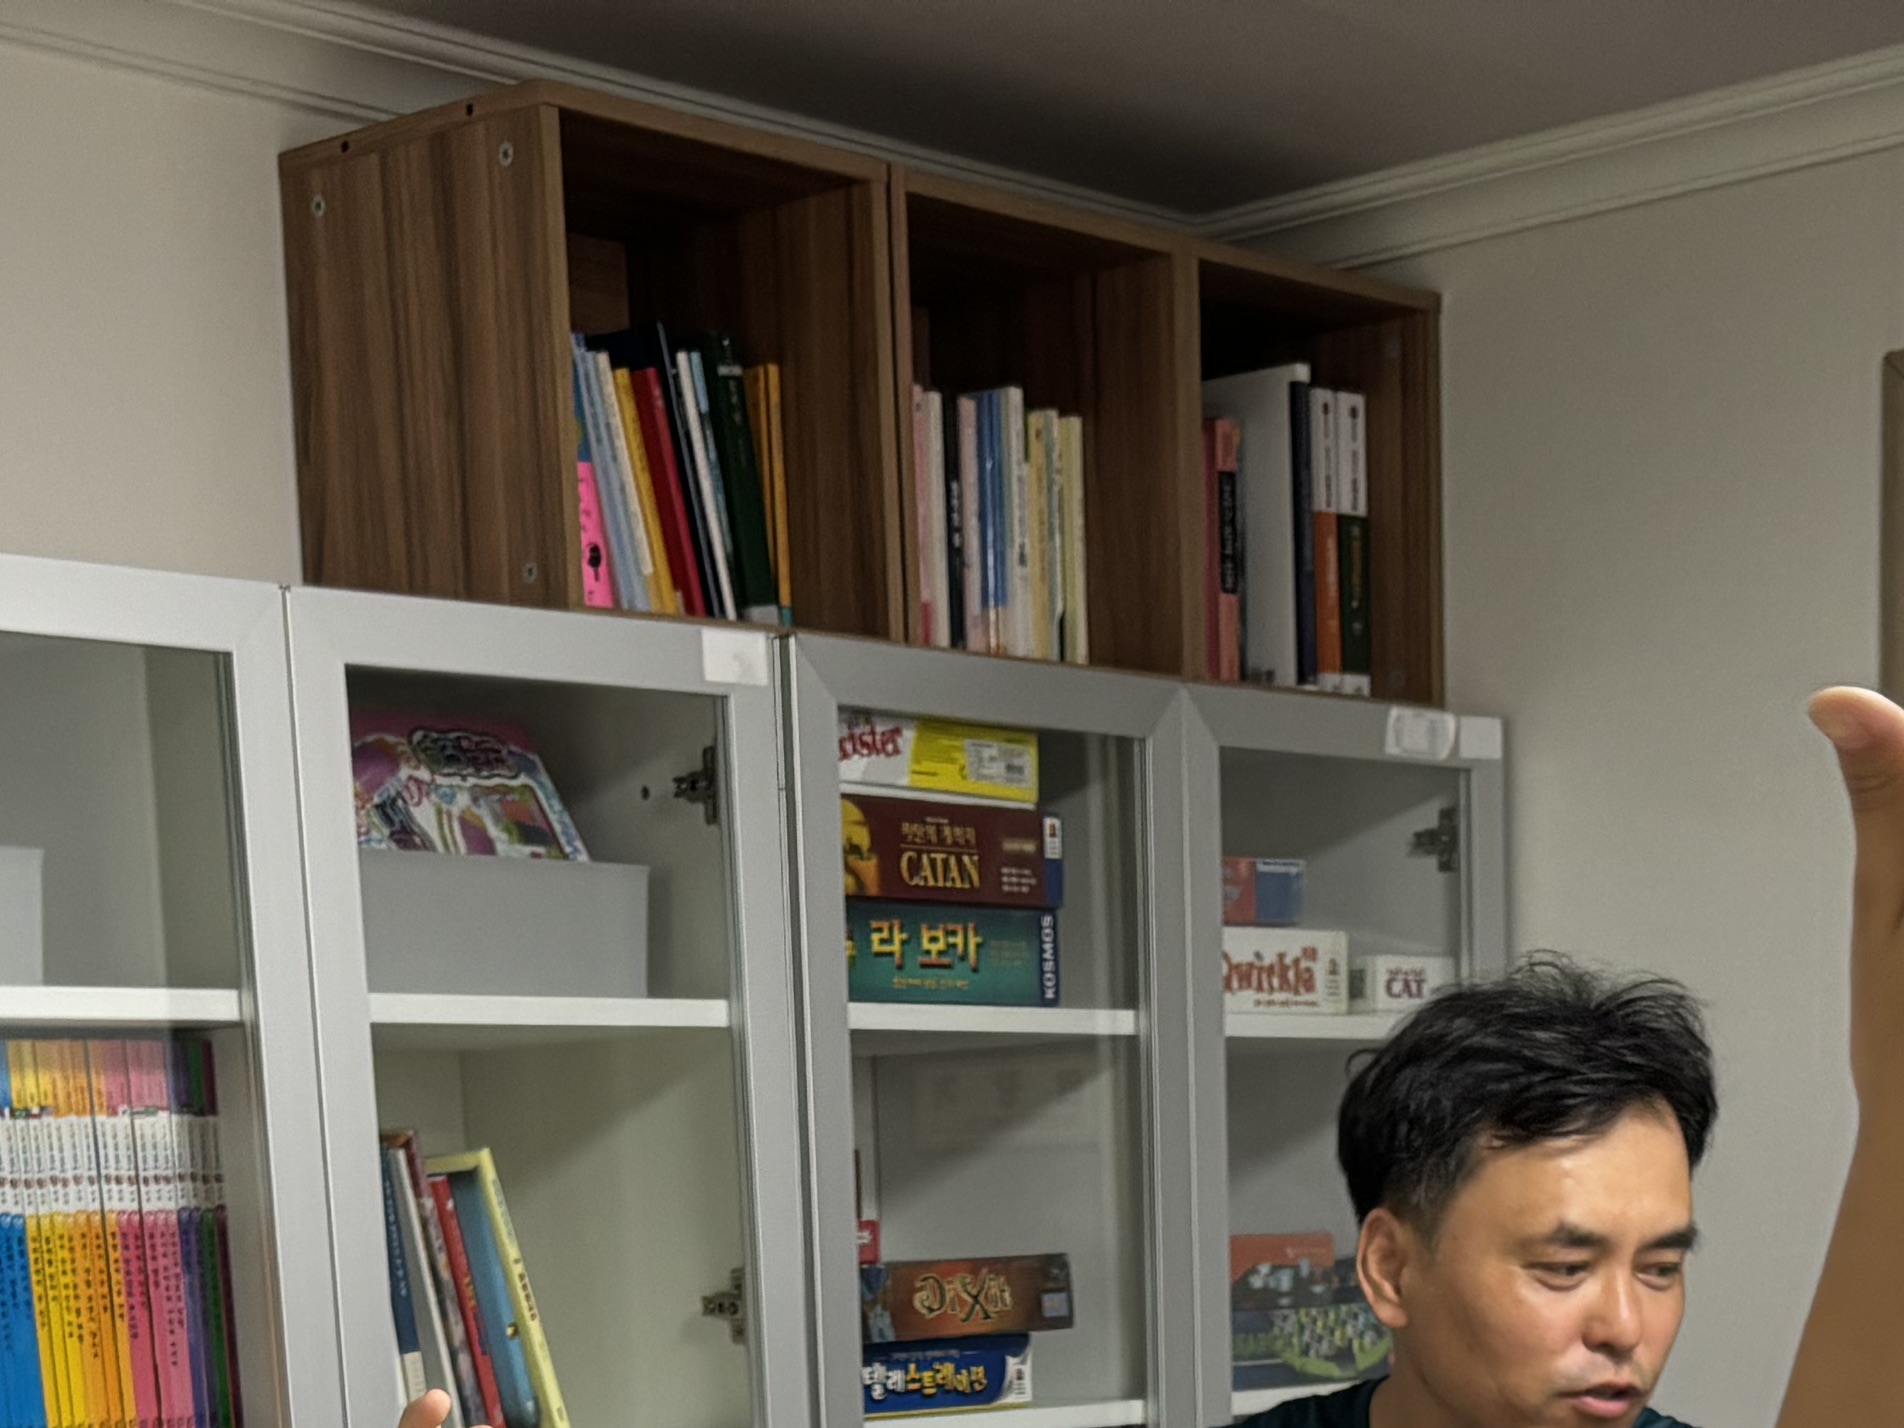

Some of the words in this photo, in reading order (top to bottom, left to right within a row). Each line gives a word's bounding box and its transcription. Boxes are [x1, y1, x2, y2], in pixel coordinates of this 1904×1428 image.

[900, 851, 981, 889] CATAN
[870, 918, 909, 969] 라
[918, 922, 983, 973] 보카
[1040, 914, 1056, 1000] KOSMOS
[1385, 978, 1427, 999] CAT
